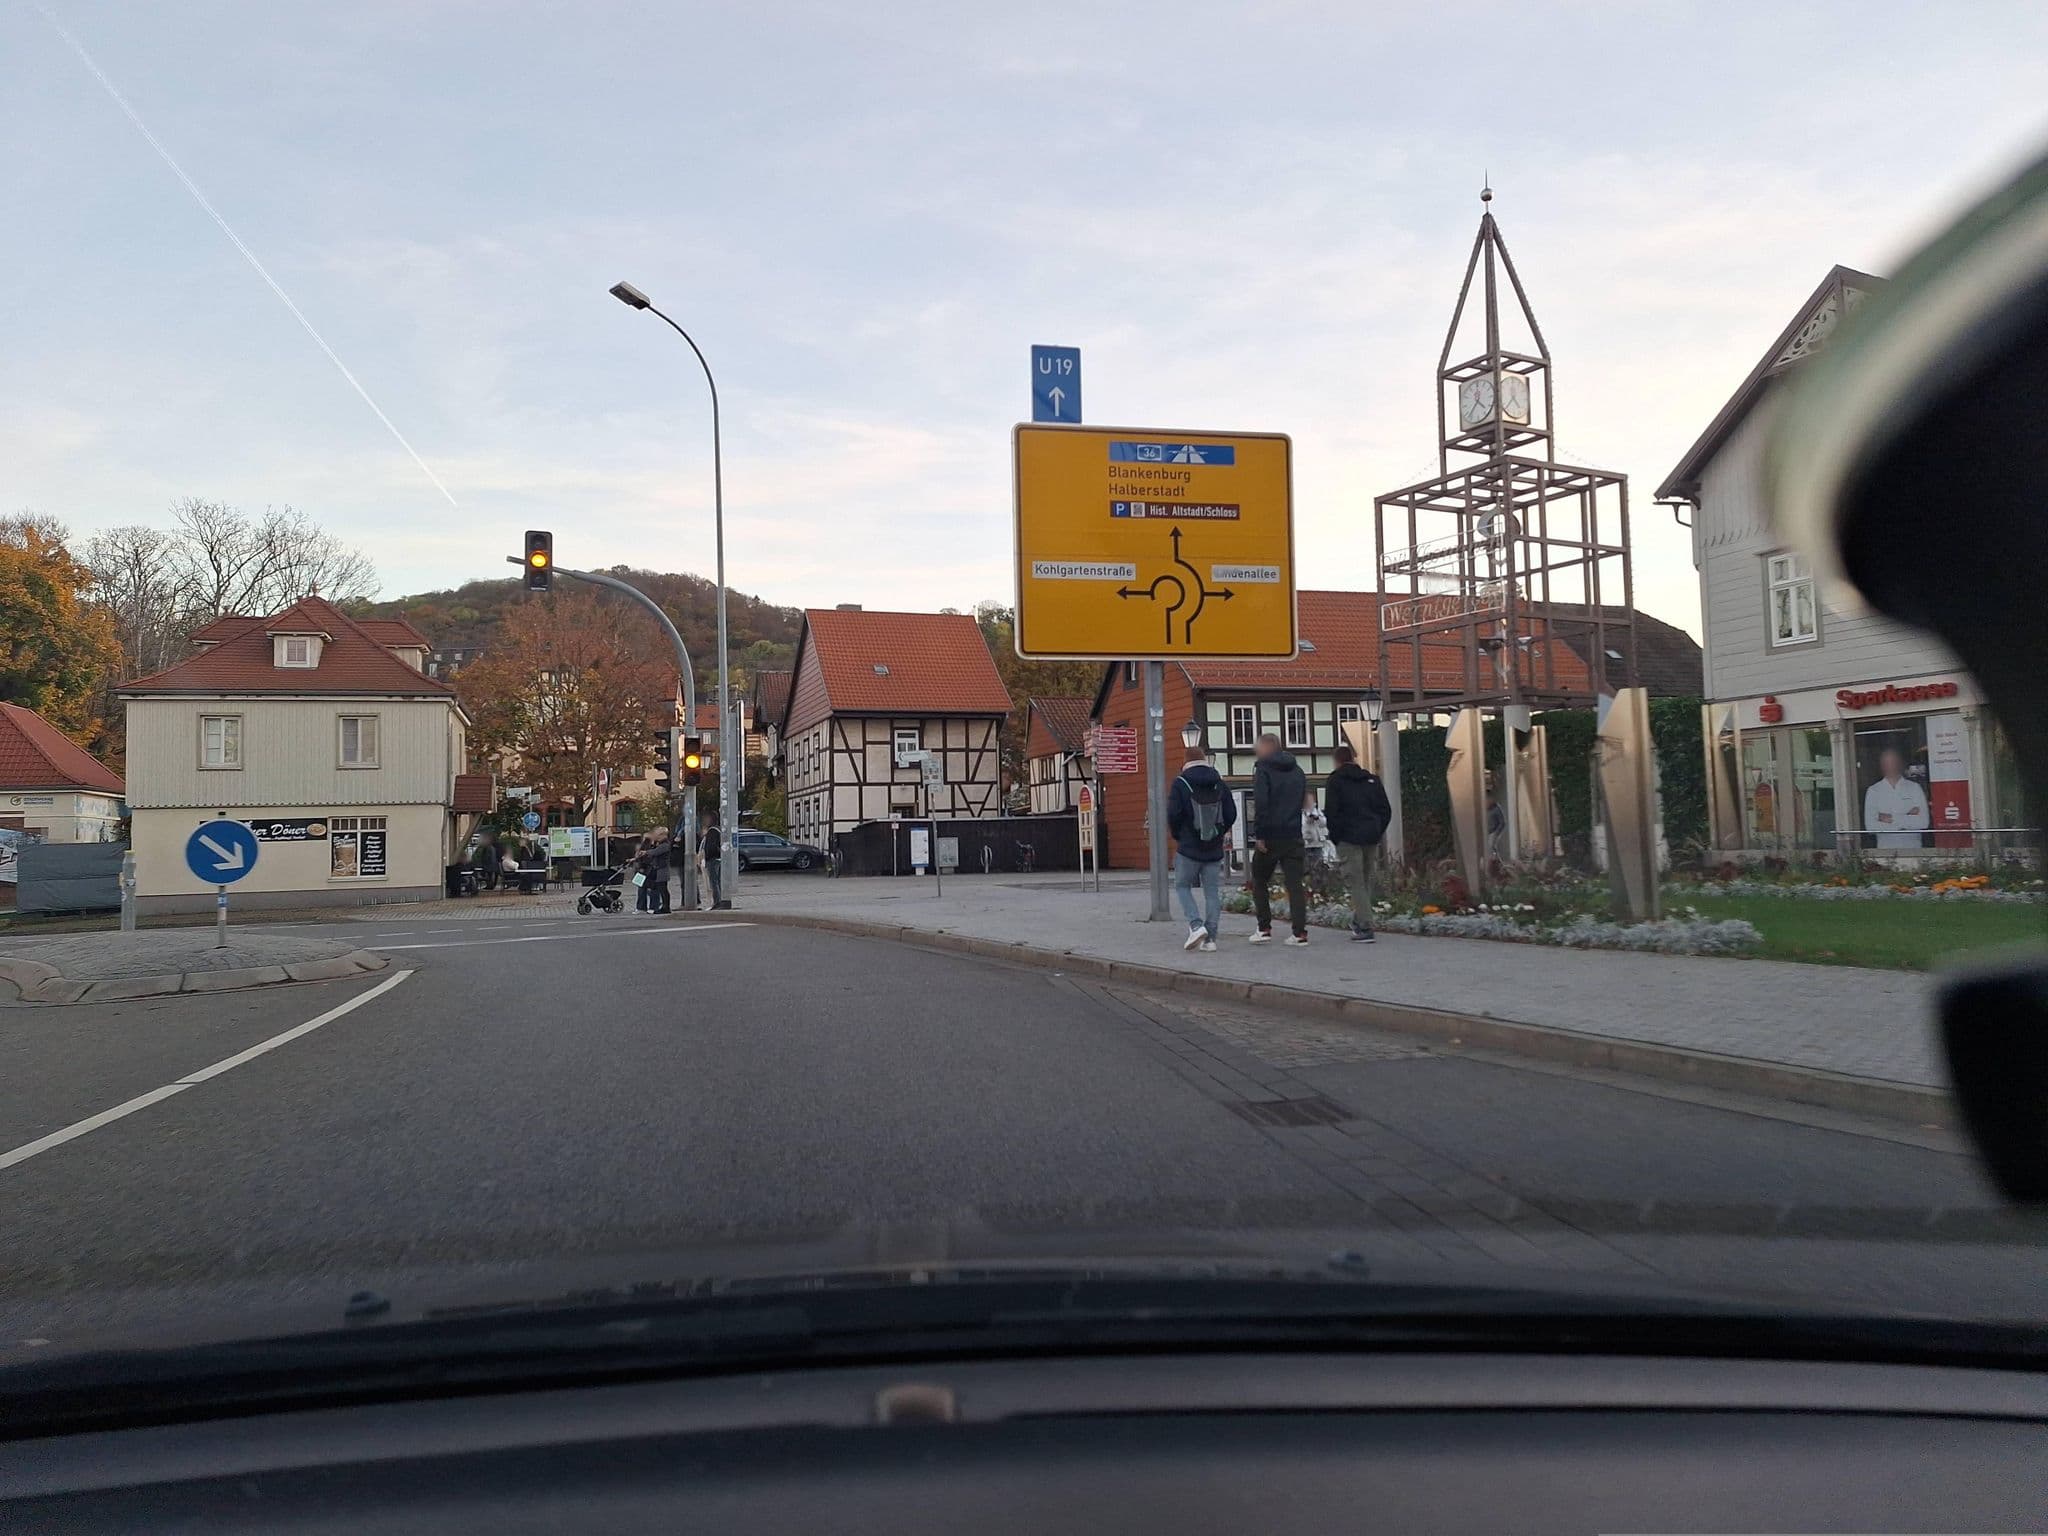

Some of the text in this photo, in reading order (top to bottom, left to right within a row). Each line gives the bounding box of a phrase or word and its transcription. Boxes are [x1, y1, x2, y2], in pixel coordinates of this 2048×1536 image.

[1143, 447, 1156, 458] 36
[1108, 466, 1191, 483] Blankenburg
[1108, 483, 1185, 496] Halberstadt
[1115, 503, 1238, 518] P Hist. Altstadt/Schloss
[1035, 563, 1133, 577] Kohlgartenstraße
[1214, 566, 1277, 579] ndenallee
[1836, 682, 1958, 710] Sparkasse
[270, 824, 307, 836] Döner
